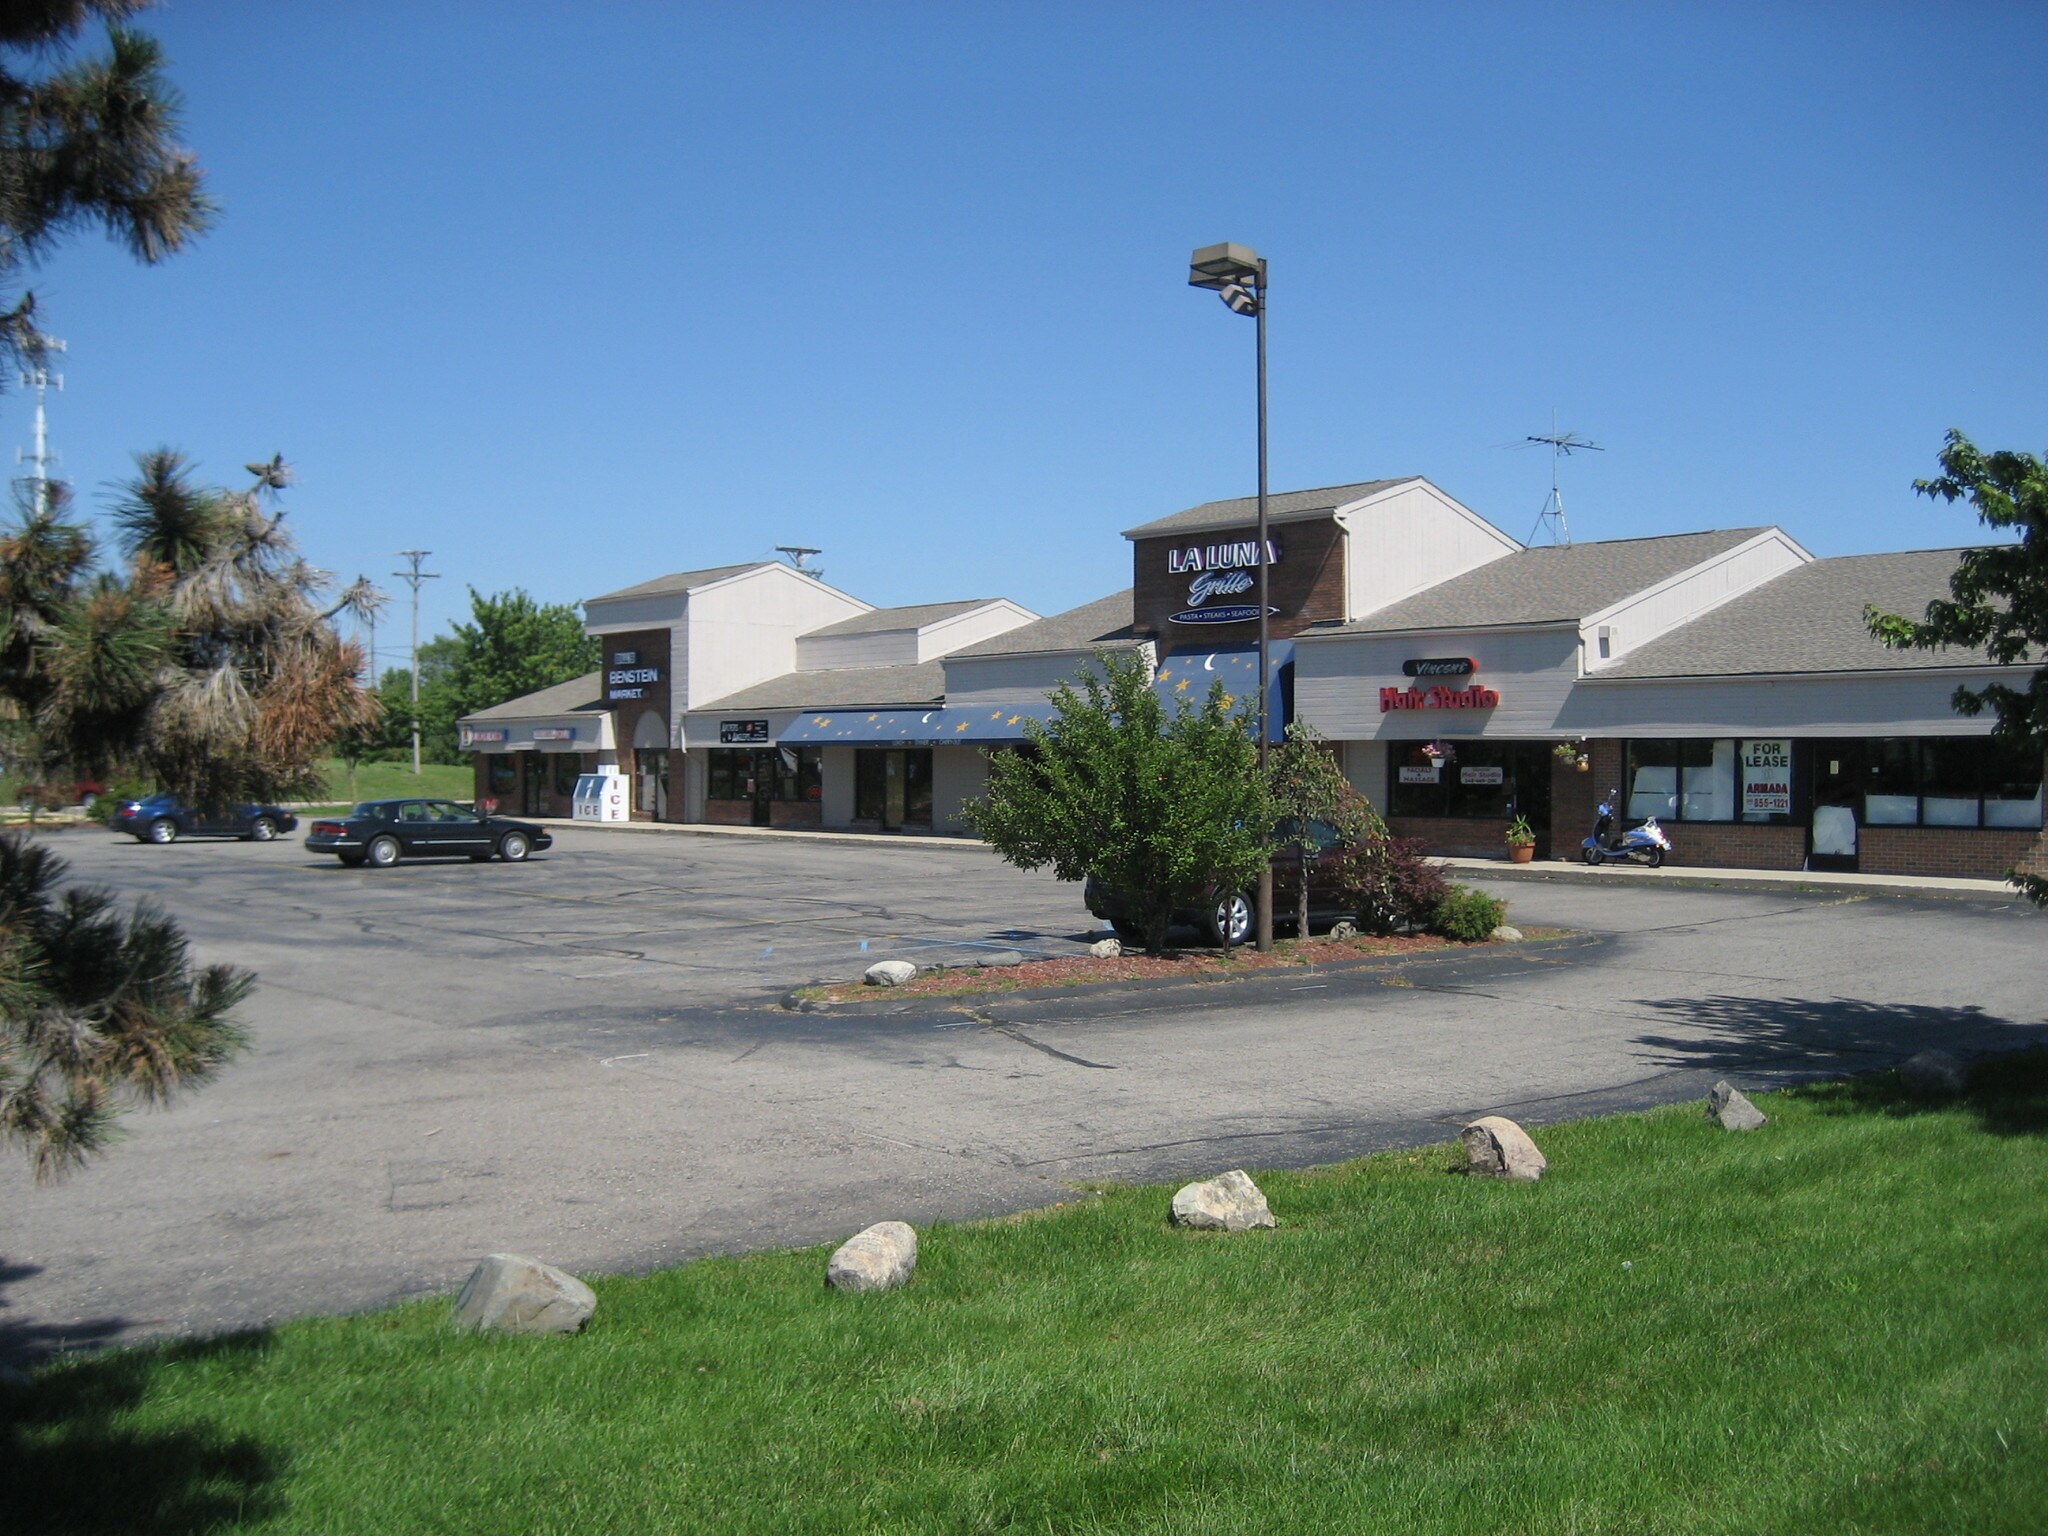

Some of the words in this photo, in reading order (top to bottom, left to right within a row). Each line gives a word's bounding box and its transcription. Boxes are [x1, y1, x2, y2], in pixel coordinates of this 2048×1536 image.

[1168, 547, 1203, 574] LA
[1187, 571, 1254, 606] Grille
[1180, 612, 1199, 621] PASTA
[1203, 611, 1226, 620] STEAKS
[1231, 608, 1260, 617] SEAFOO
[610, 668, 658, 684] BENSTEIN
[609, 688, 643, 699] MARKET
[1380, 687, 1425, 712] Hair
[1428, 685, 1499, 709] Studio
[1753, 743, 1781, 755] FOR
[1745, 755, 1789, 767] LEASE
[1746, 783, 1788, 793] ARMADA
[610, 780, 621, 820] ICE
[1754, 798, 1789, 808] 855-1221
[578, 804, 599, 816] ICE
